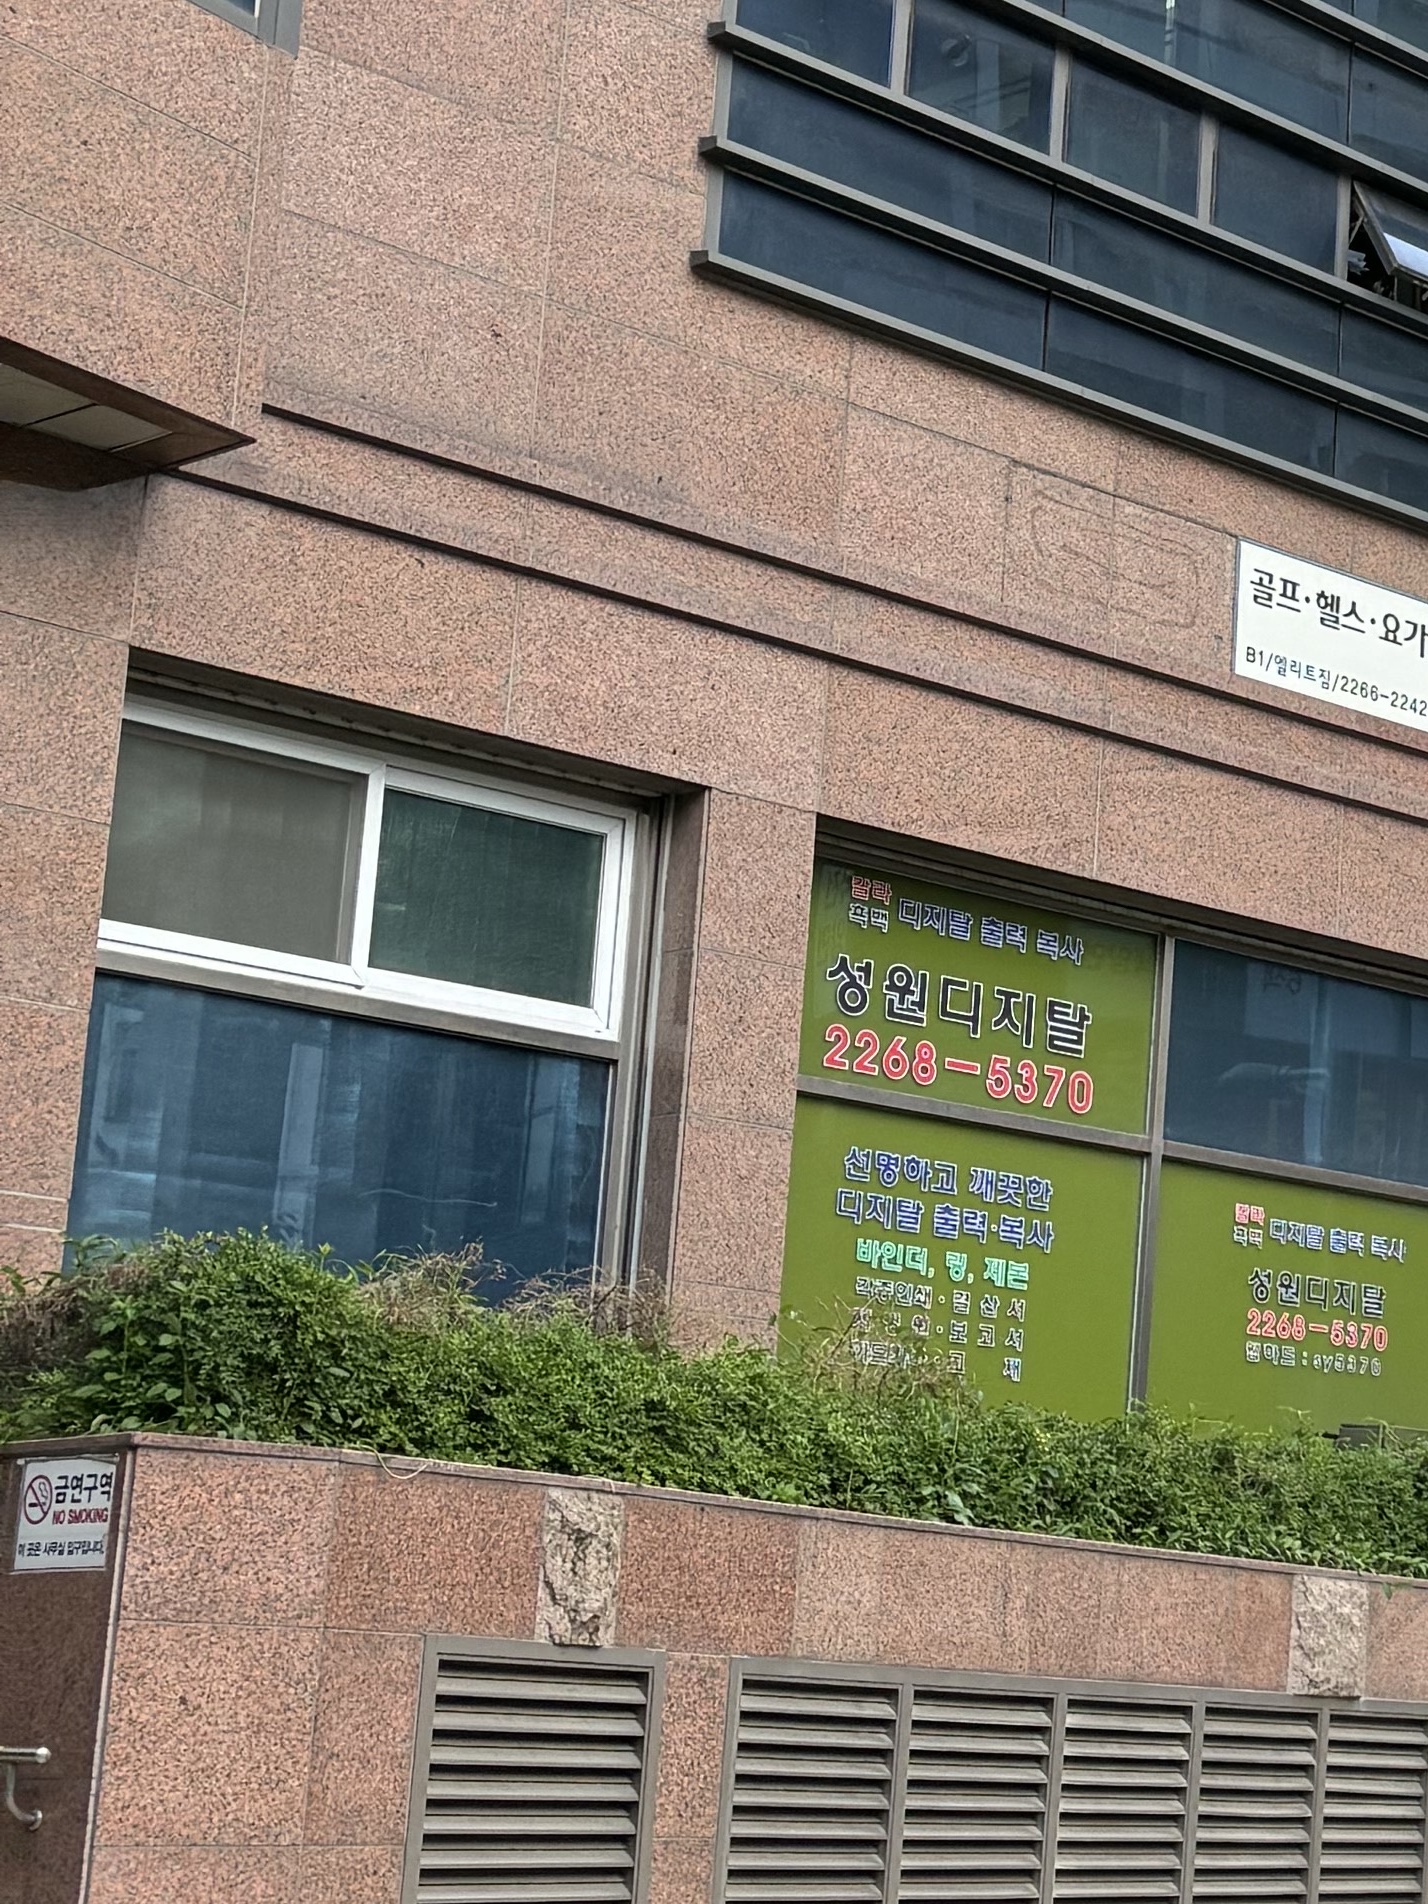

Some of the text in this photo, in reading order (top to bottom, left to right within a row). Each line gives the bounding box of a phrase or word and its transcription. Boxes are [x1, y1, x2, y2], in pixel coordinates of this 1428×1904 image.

[898, 898, 1084, 966] 디지탈 출력 복사
[826, 953, 1092, 1058] 성원디지탈
[822, 1024, 1094, 1115] 2268-5370
[844, 1146, 1053, 1211] 선명하고 깨끗한
[836, 1188, 925, 1234] 디지탈
[1269, 1218, 1407, 1263] 디지탈 출력 복사
[983, 1256, 1030, 1290] 제본
[1247, 1267, 1387, 1319] 성원디지탈
[1246, 1307, 1388, 1352] 2268-5370
[54, 1472, 114, 1505] 금연구역
[53, 1507, 109, 1524] NO SMOKING
